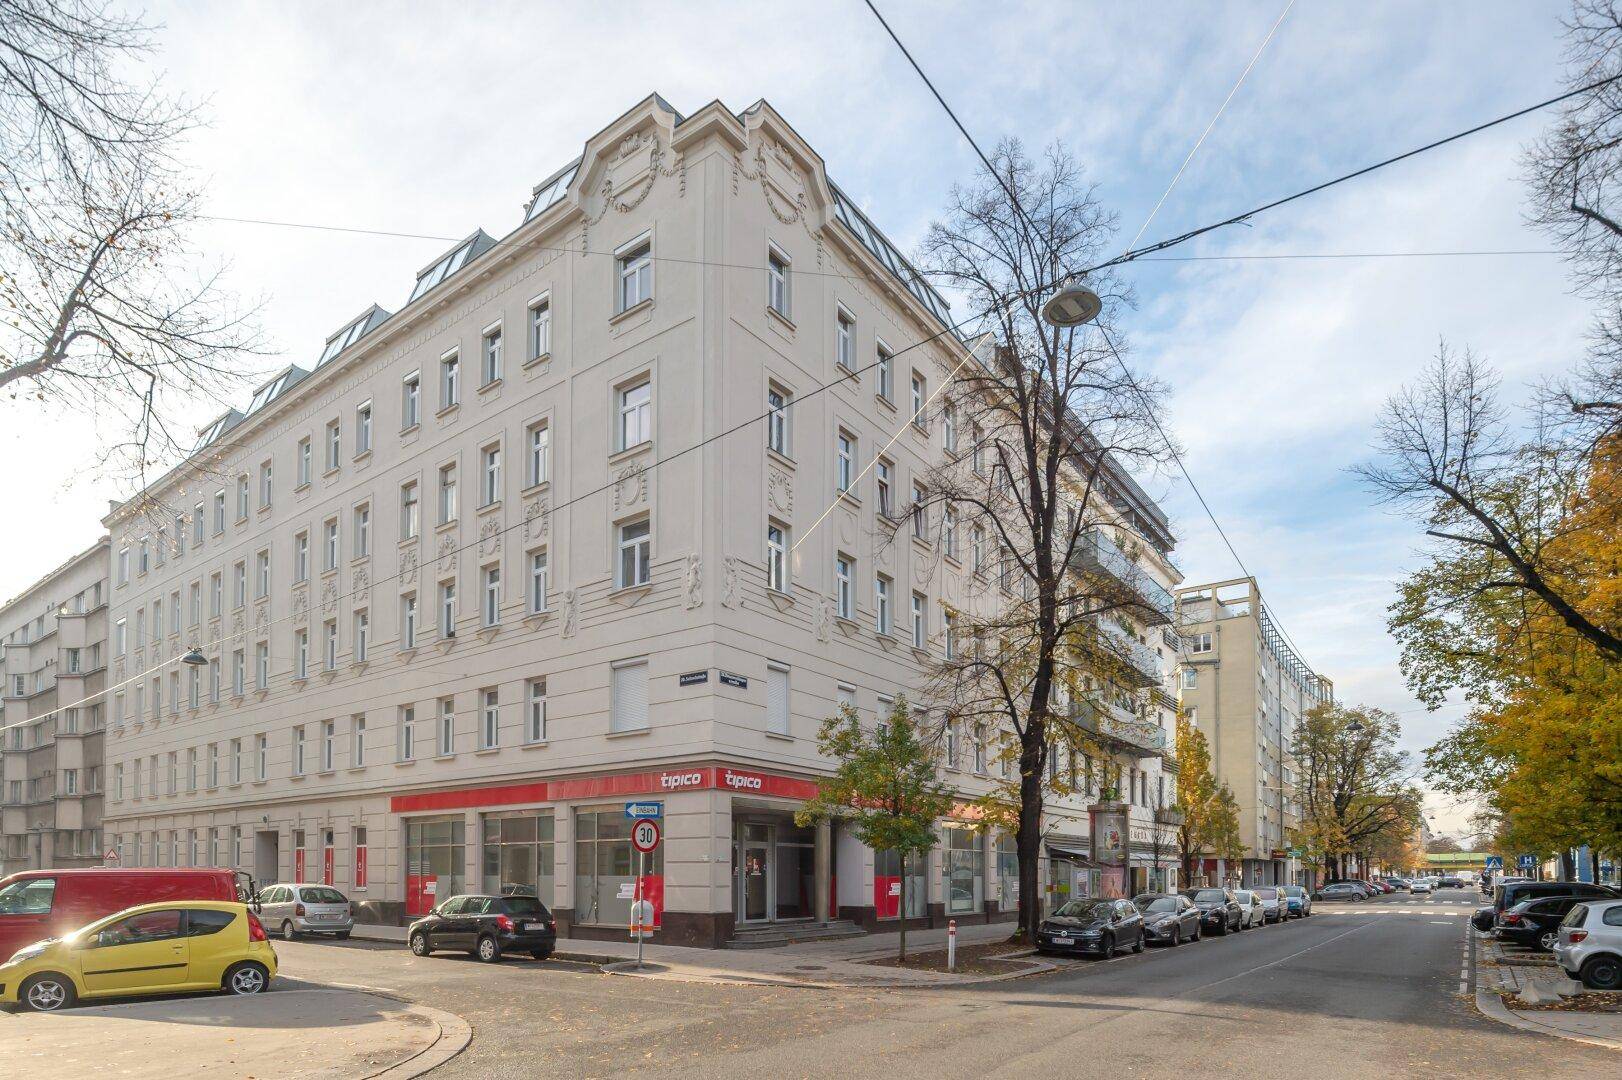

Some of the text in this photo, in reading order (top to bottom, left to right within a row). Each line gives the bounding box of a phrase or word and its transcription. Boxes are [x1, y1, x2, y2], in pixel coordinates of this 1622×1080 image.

[660, 772, 702, 789] tipico
[725, 770, 761, 789] tipico
[636, 806, 656, 814] EINBAHN
[639, 827, 653, 843] 30
